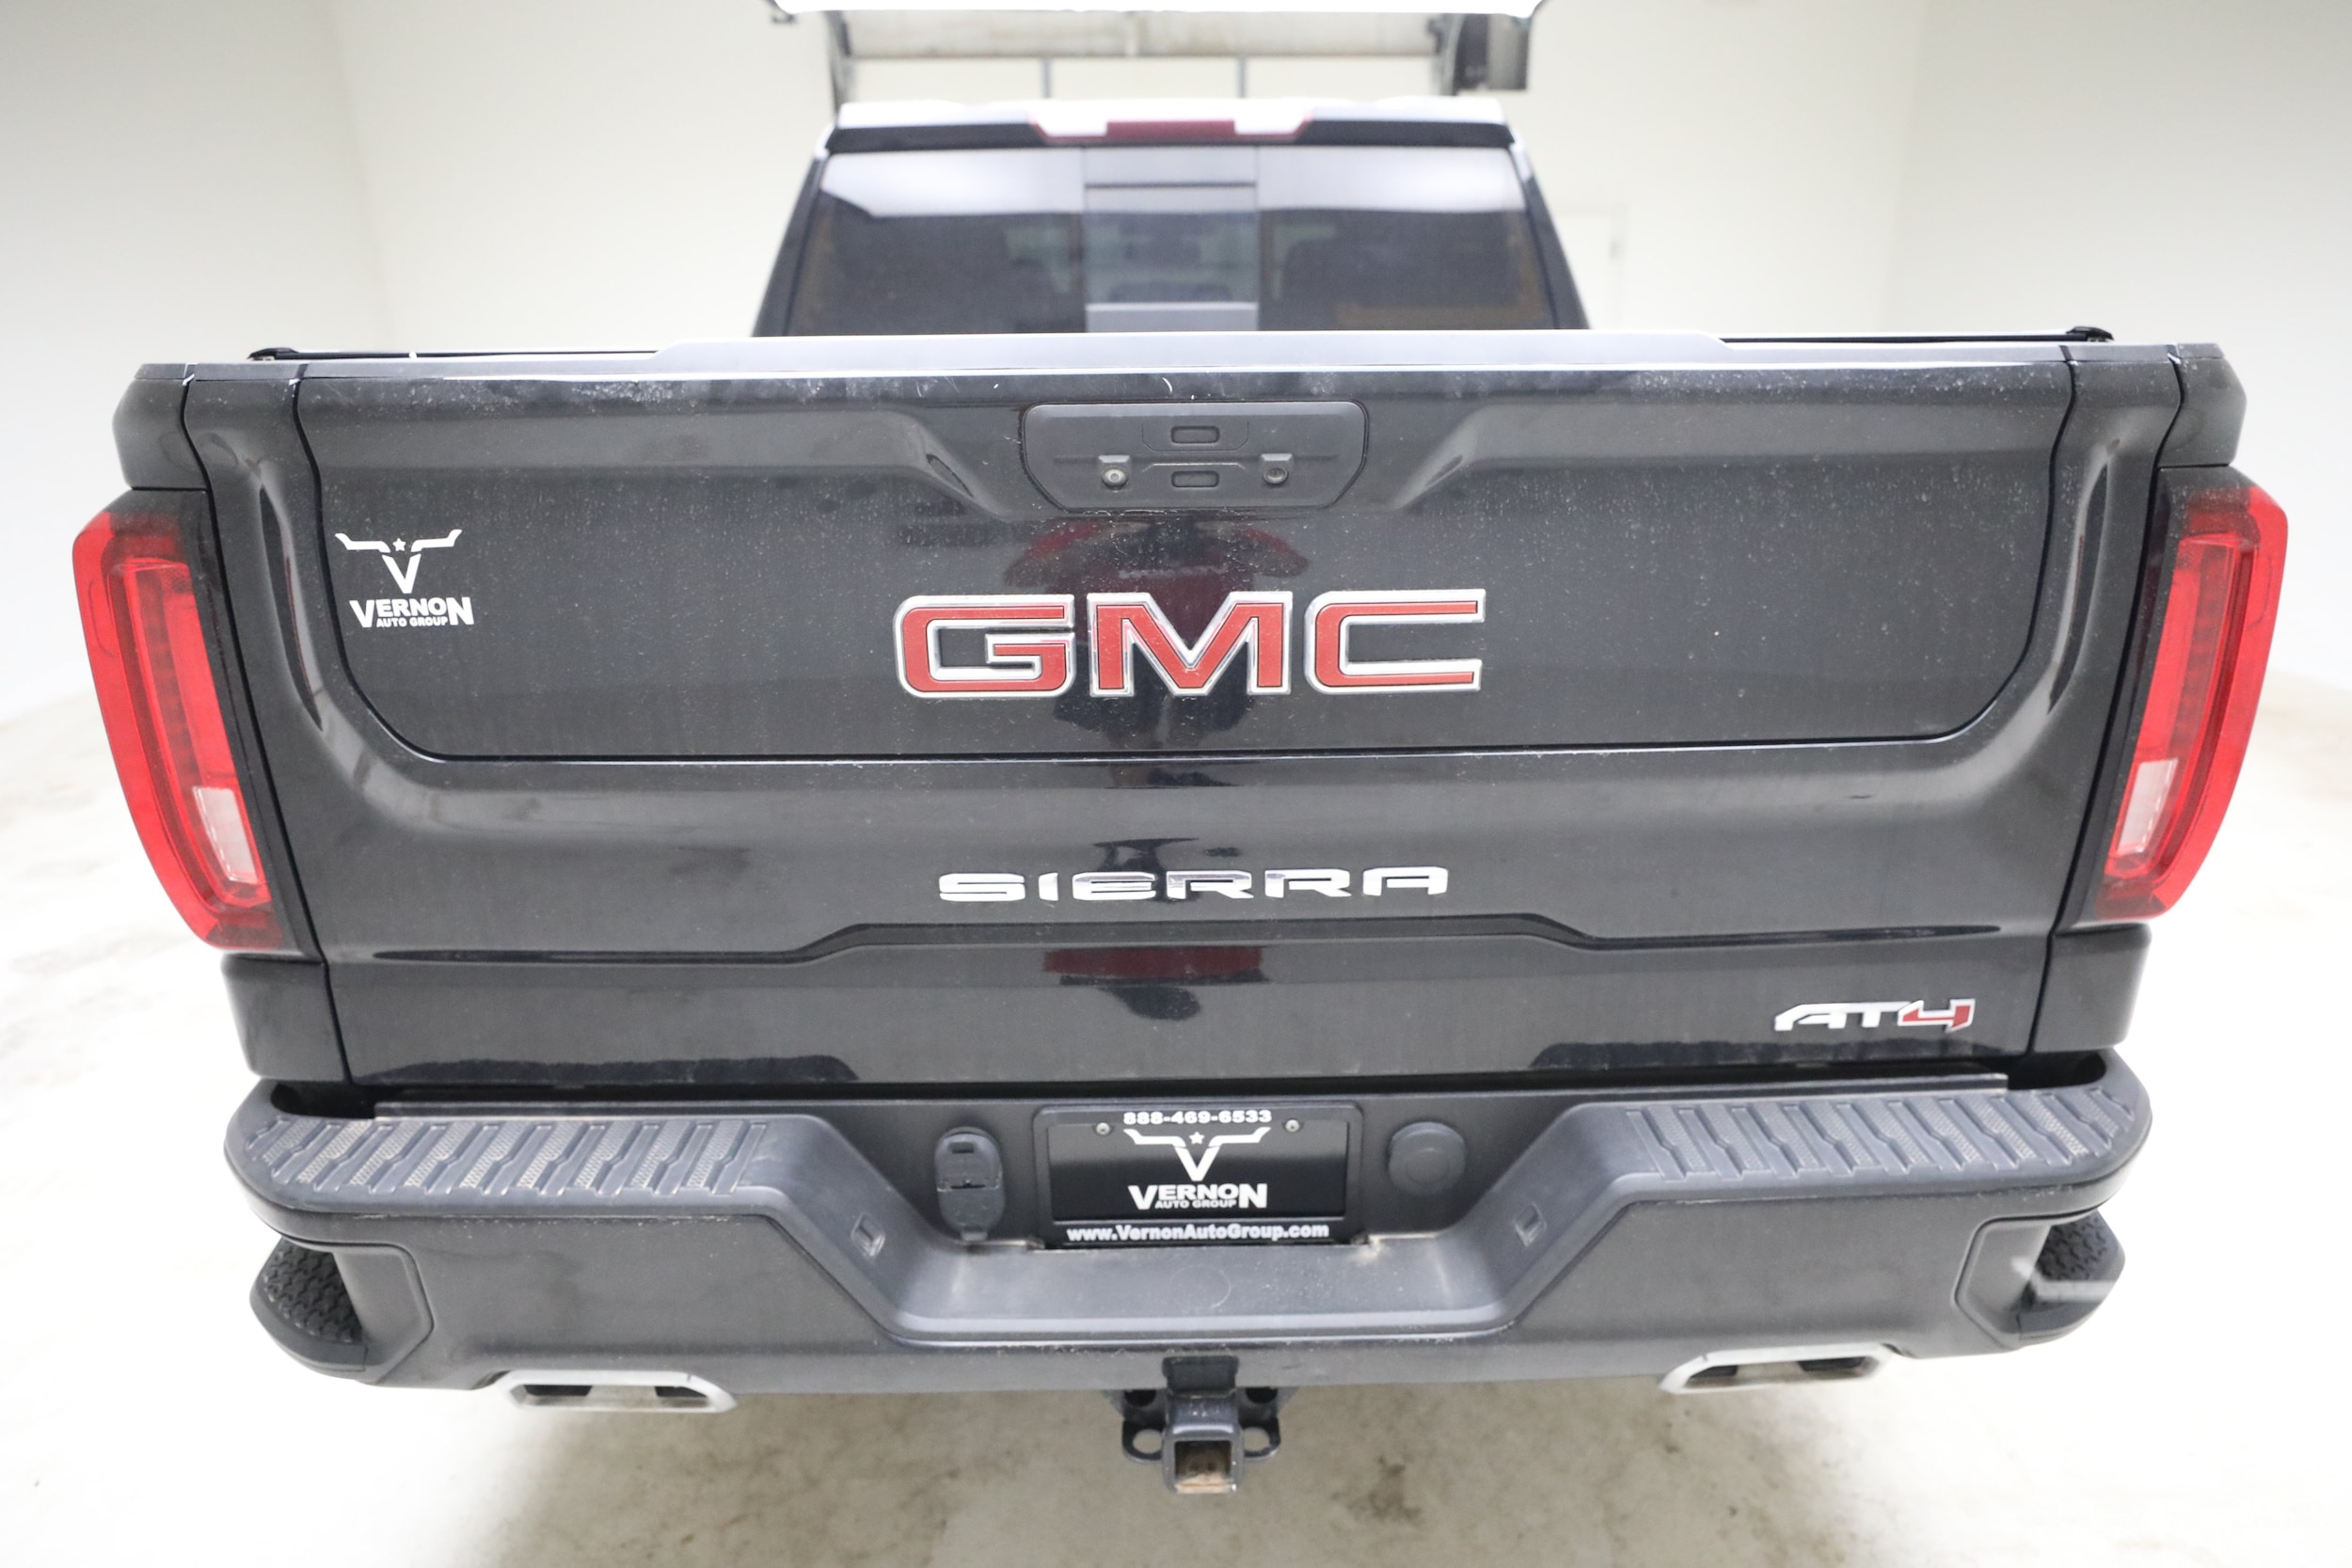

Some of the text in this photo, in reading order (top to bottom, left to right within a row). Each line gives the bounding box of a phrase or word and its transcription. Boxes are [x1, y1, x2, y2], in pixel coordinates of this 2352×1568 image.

[349, 596, 474, 628] VERNON
[376, 616, 449, 627] AUTO GROUP
[894, 589, 1486, 699] GMC
[939, 866, 1449, 902] SIERRA
[1774, 998, 1976, 1033] AT4
[1123, 1109, 1272, 1125] 888-469-6533
[1128, 1183, 1267, 1210] VERNON
[1154, 1199, 1237, 1210] AUTO GROUP
[1066, 1223, 1329, 1242] www.VernonAutoGroup.com
